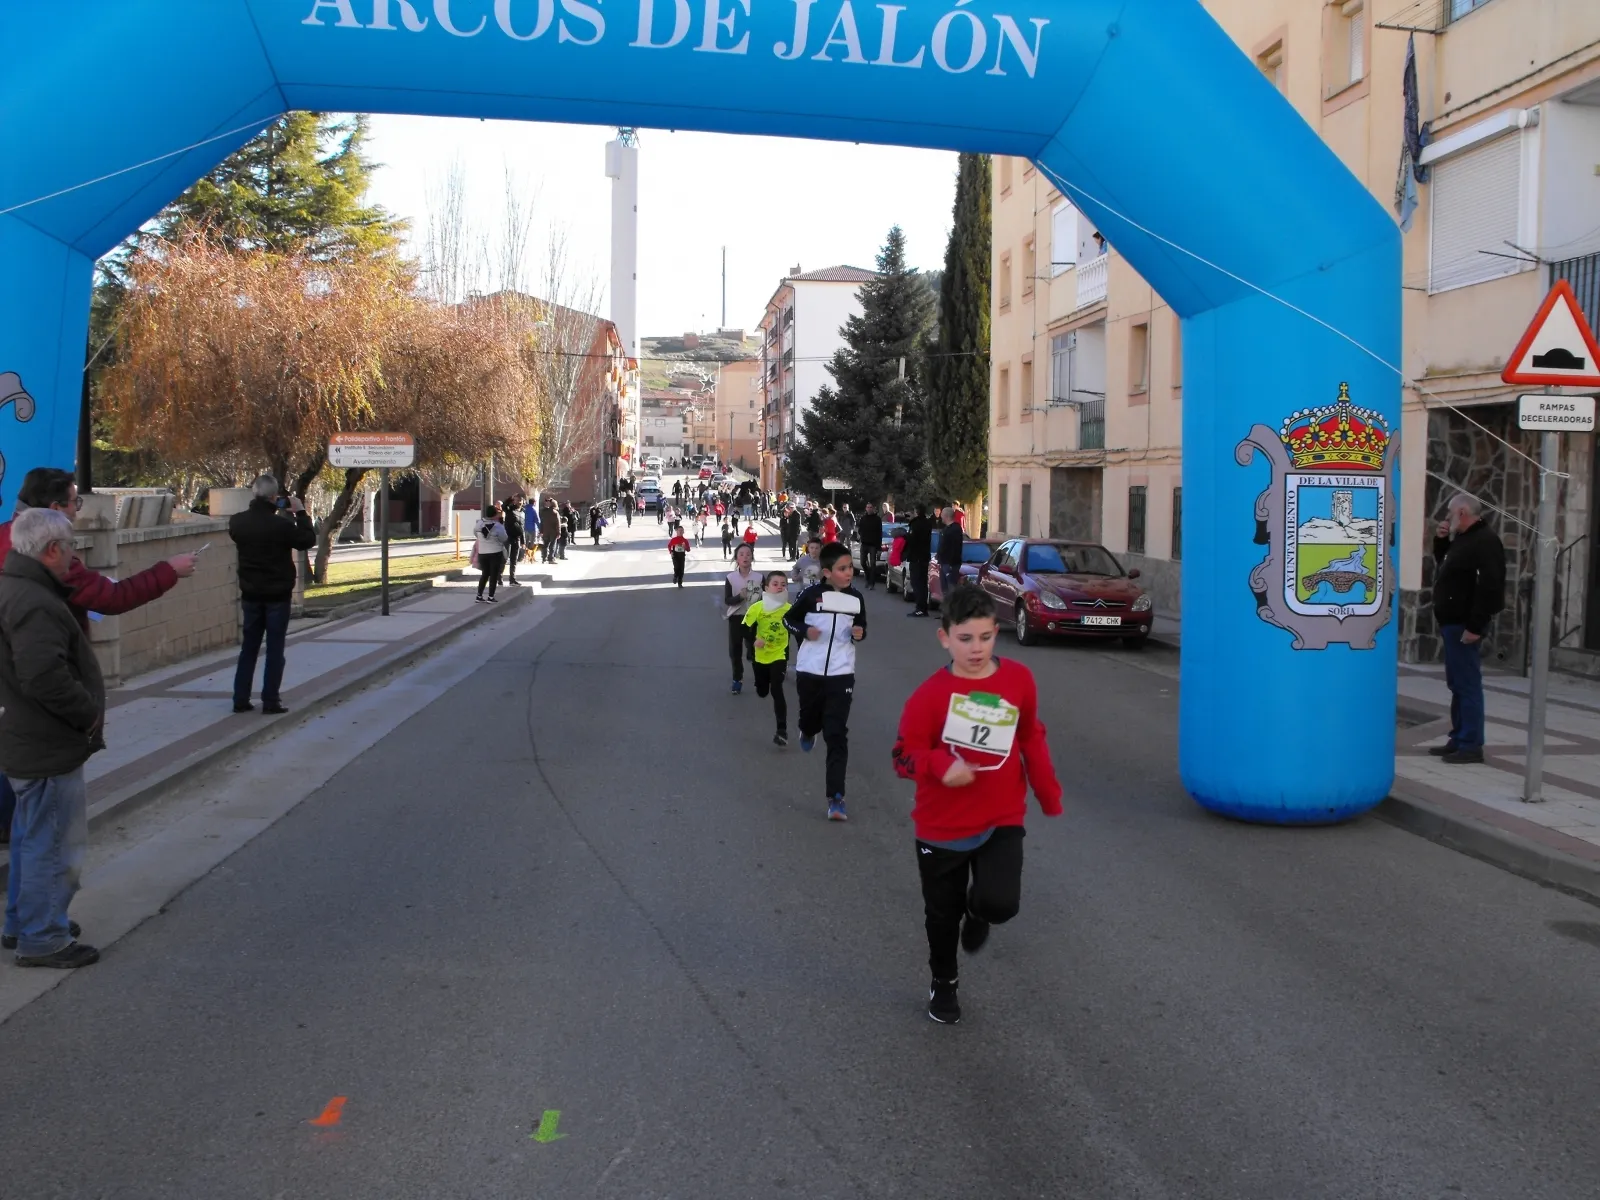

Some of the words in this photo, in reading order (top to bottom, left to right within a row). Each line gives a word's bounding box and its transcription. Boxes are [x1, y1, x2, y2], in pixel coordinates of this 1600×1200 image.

[629, 0, 751, 55] DE
[772, 0, 1050, 78] JALÓN
[1539, 403, 1576, 412] RAMPAS
[1521, 414, 1593, 424] DECELERADORAS
[344, 435, 380, 443] Polideportivo
[1299, 476, 1315, 485] DE
[1318, 476, 1332, 485] LA
[1335, 477, 1365, 485] VILLA
[1366, 477, 1378, 486] DE
[1286, 490, 1296, 591] AYUNTAMIENTO
[1327, 606, 1355, 616] SORIA
[971, 725, 991, 746] 12
